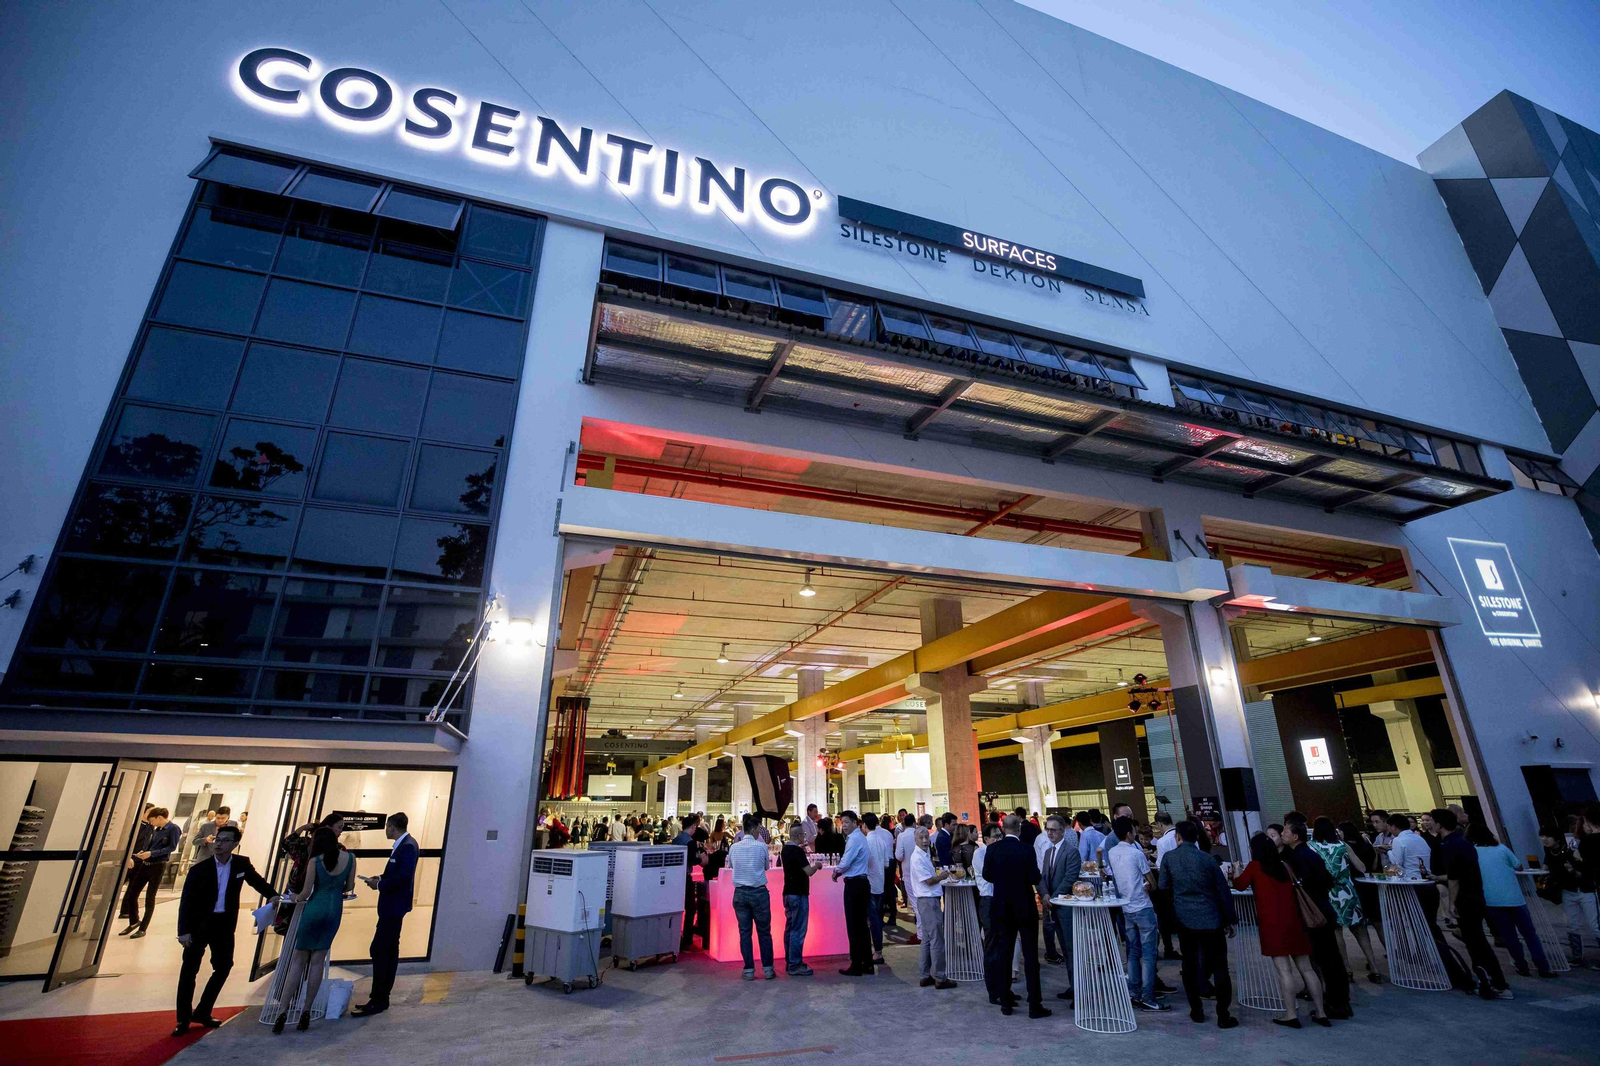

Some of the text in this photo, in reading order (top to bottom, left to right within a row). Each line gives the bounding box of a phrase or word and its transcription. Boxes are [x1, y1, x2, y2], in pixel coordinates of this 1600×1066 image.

[238, 47, 814, 226] COSENTINO
[840, 222, 1150, 317] SILESTONE DEKTON SENSA
[962, 231, 1057, 271] SURFACES
[1479, 596, 1523, 610] SILESTONE
[604, 741, 649, 749] COSENTINO
